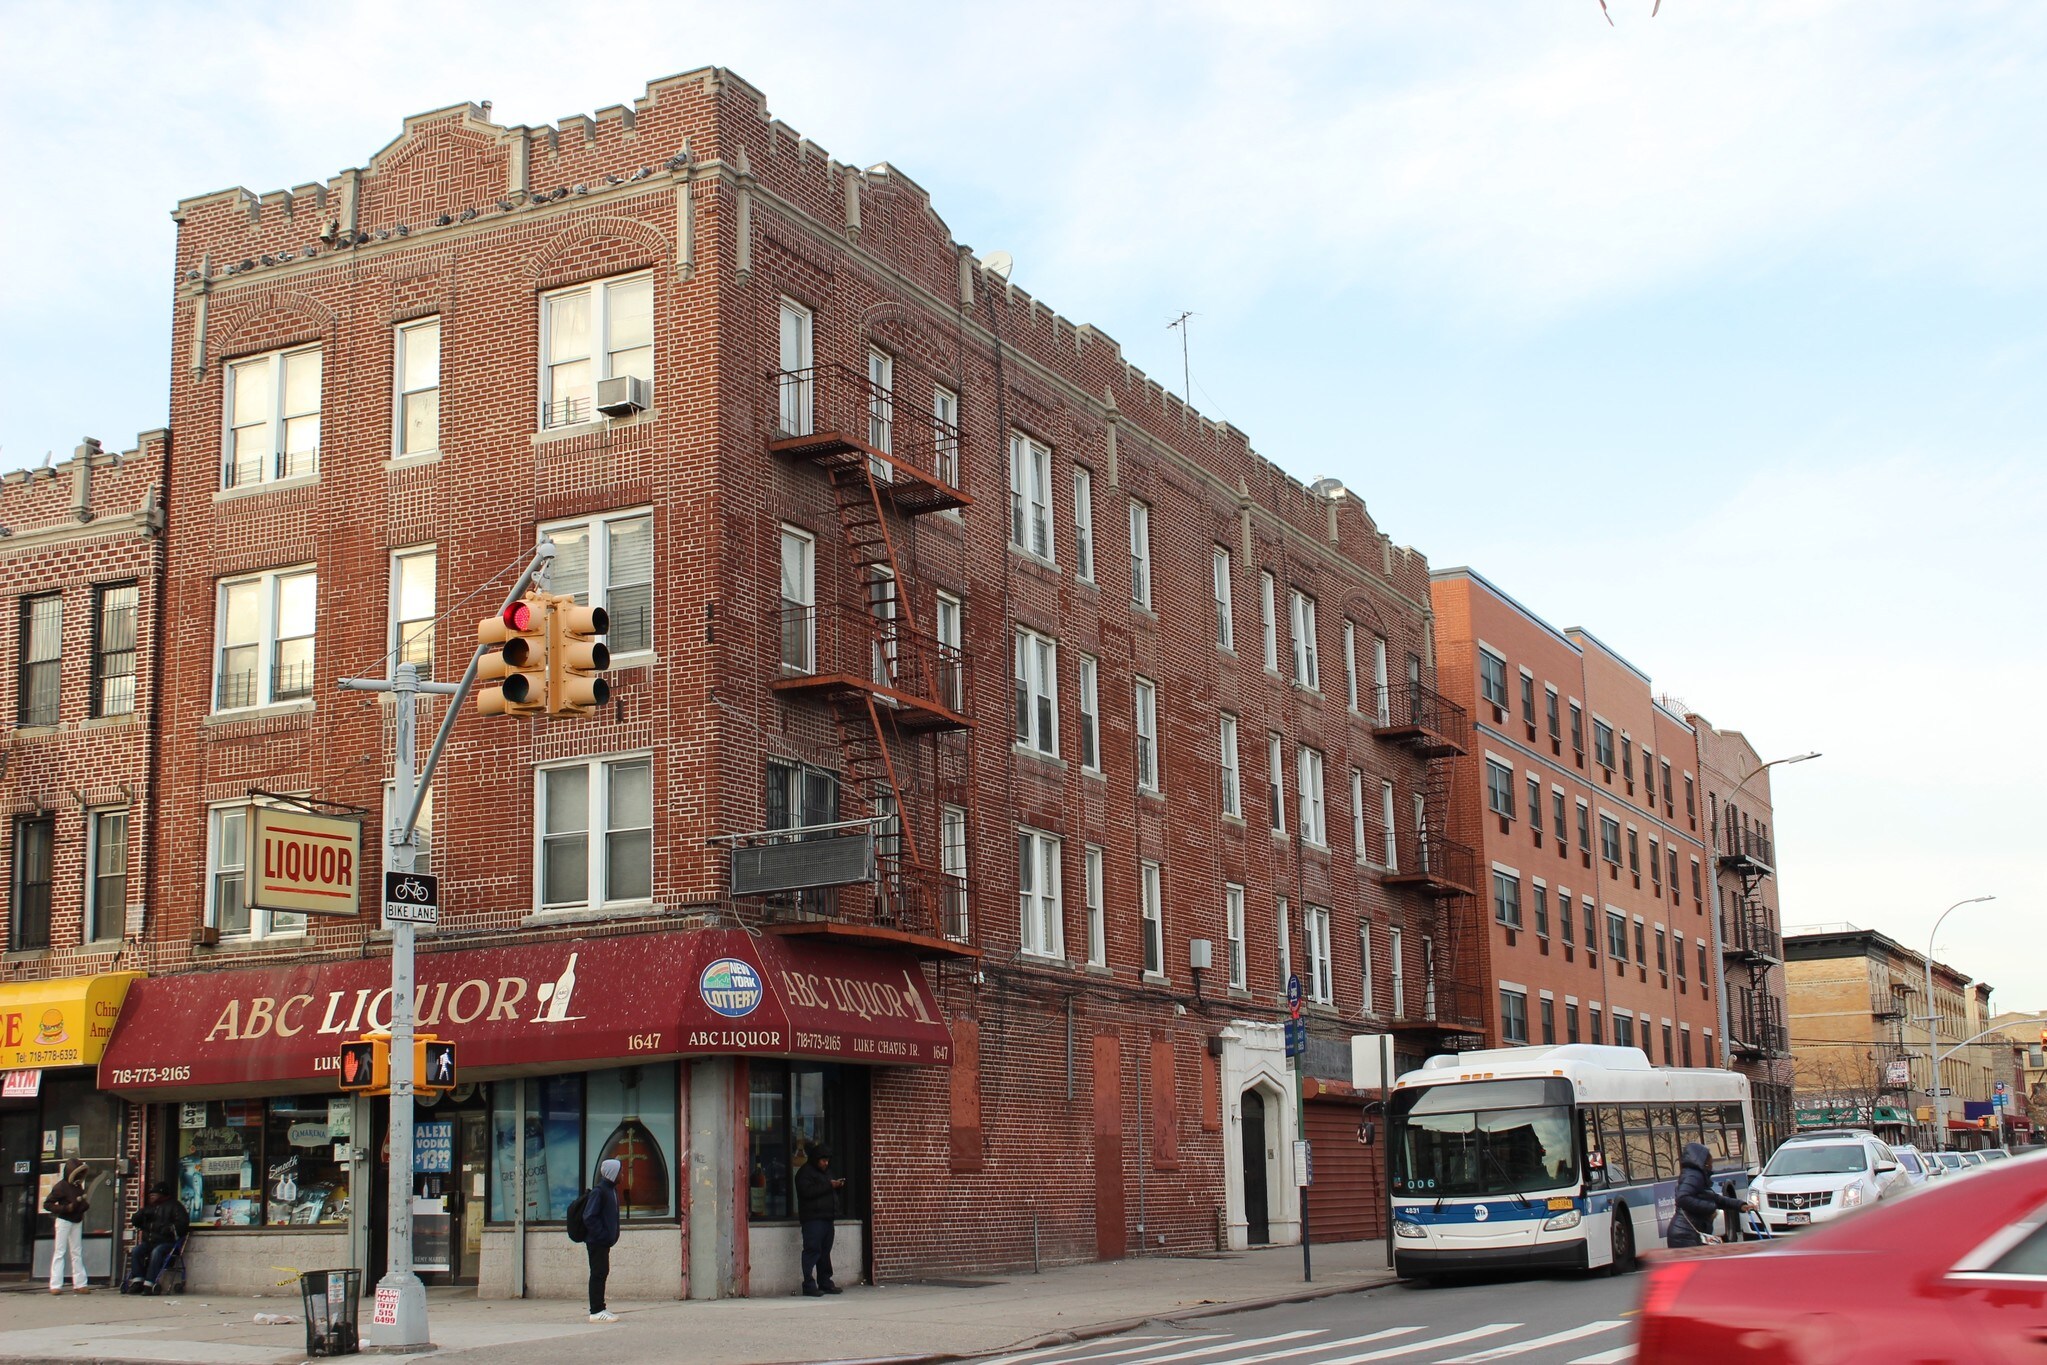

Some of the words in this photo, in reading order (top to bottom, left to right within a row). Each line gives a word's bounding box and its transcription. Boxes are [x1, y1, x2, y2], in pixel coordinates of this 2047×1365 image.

[265, 838, 353, 887] LIQUOR
[388, 904, 408, 918] BIKE
[413, 905, 435, 920] LANE
[730, 961, 750, 975] NEW
[732, 976, 756, 988] YORK
[704, 989, 759, 1009] LOTTERY
[781, 970, 829, 1010] ABC
[824, 976, 909, 1022] LIQUOR
[204, 994, 315, 1042] ABC
[628, 1033, 661, 1050] 1647
[688, 1031, 719, 1046] ABC
[722, 1031, 780, 1048] LIQUOR
[796, 1032, 842, 1051] 718-773-2165
[853, 1038, 875, 1053] LUKE
[877, 1041, 907, 1056] CHAVIS
[909, 1045, 920, 1057] JR.
[933, 1046, 948, 1060] 1647
[29, 1048, 78, 1062] 718-778-6392
[112, 1065, 191, 1084] 718-773-2165
[314, 1056, 341, 1071] LUK
[8, 1070, 37, 1088] ATM
[46, 1133, 54, 1145] A
[416, 1126, 451, 1138] ALEXI
[416, 1139, 451, 1149] VODKA
[208, 1160, 240, 1172] ABSOLUT
[269, 1155, 299, 1179] Smooth
[1474, 1208, 1487, 1217] MTA
[377, 1302, 396, 1310] (917)
[378, 1309, 394, 1317] 515
[374, 1316, 396, 1325] 6499
